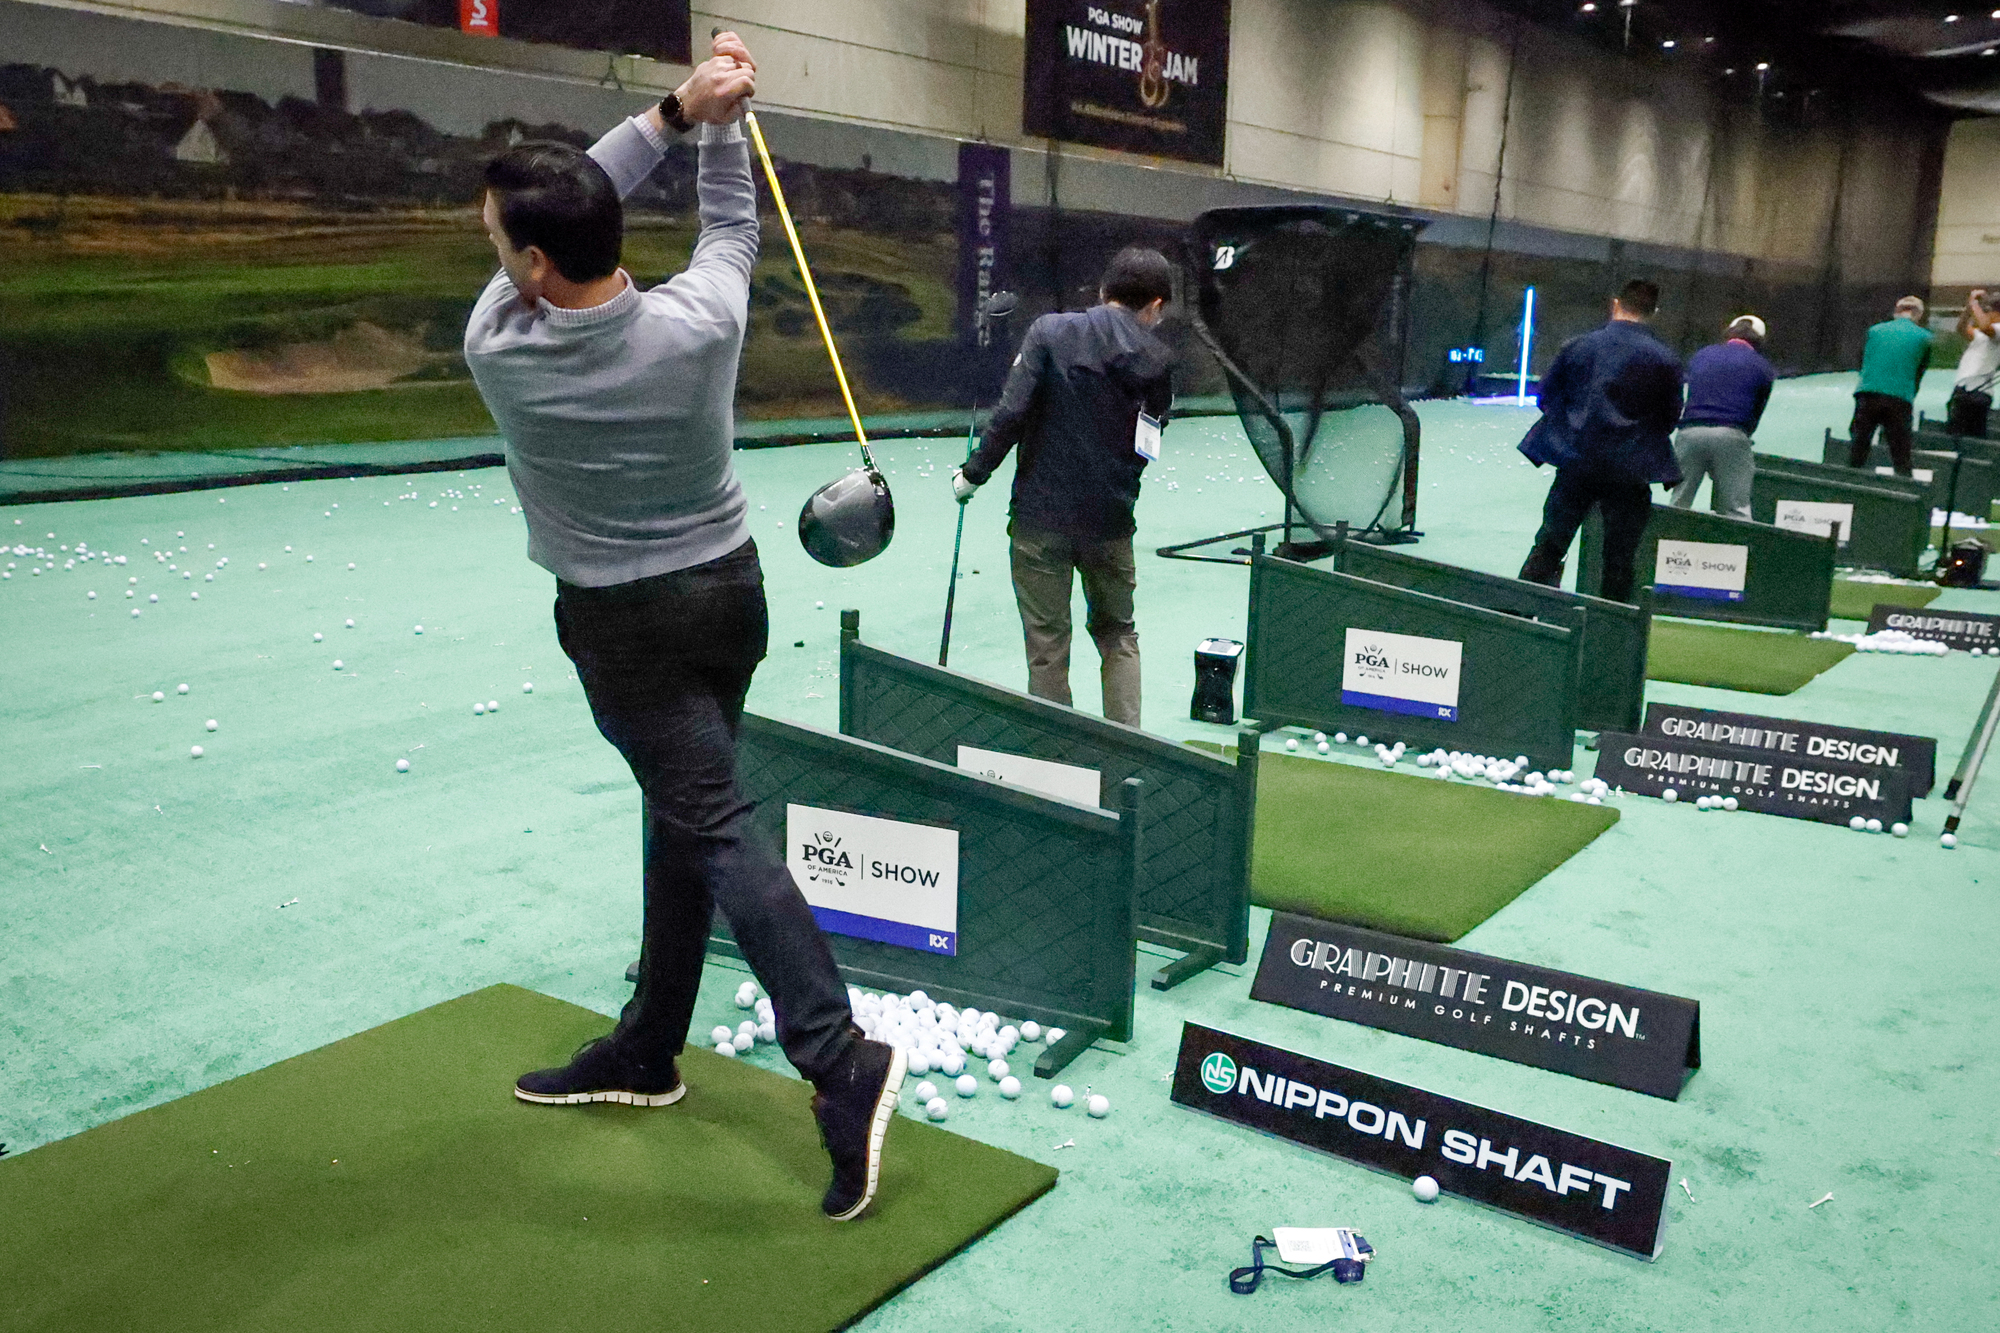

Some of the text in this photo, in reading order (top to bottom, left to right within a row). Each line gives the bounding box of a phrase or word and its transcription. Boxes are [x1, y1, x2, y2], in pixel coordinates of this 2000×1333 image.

[1088, 7, 1143, 34] PGA SHOW
[1066, 25, 1198, 84] WINTER JAM
[1665, 557, 1736, 572] PGA SHOW
[1886, 613, 1994, 637] GRAPHITE
[1355, 653, 1448, 679] PGA SHOW
[1661, 717, 1899, 767] GRAPHITE DESIGN
[1624, 747, 1880, 800] GRAPHITE DESIGN
[1648, 774, 1850, 808] PREMIUM GOLF SHAFTS
[802, 844, 940, 888] PGA SHOW
[818, 867, 848, 876] AMERICA
[929, 933, 949, 949] RX
[1290, 938, 1491, 1005] GRAPHITE
[1502, 980, 1640, 1039] DESIGN
[1320, 980, 1595, 1049] PREMIUM GOLF SHAFTS
[1238, 1066, 1427, 1150] NIPPON
[1441, 1129, 1632, 1210] SHAFT
